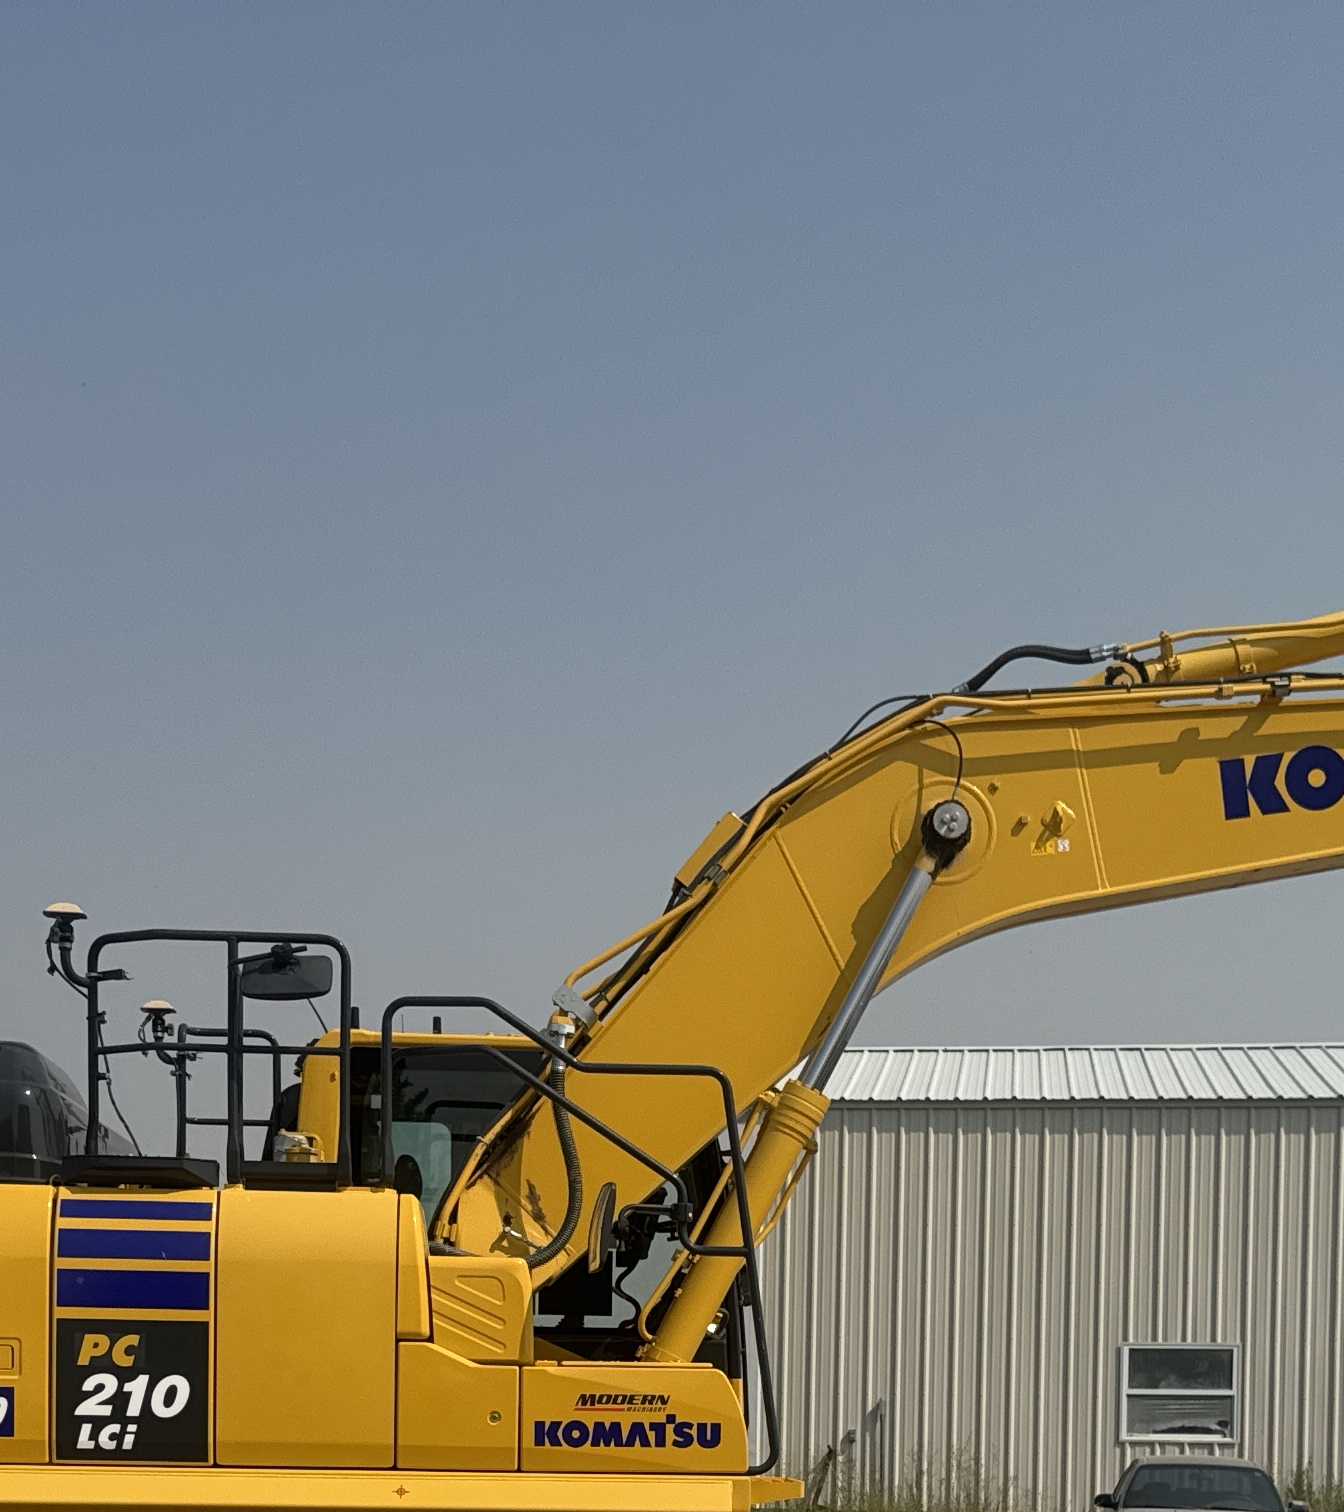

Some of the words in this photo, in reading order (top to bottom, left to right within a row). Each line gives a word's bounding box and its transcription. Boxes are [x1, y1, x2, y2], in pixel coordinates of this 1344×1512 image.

[76, 1333, 140, 1367] PC
[73, 1373, 191, 1419] 210
[575, 1393, 671, 1406] MODERN
[76, 1423, 138, 1450] LCi
[534, 1414, 722, 1449] KOMATSU
